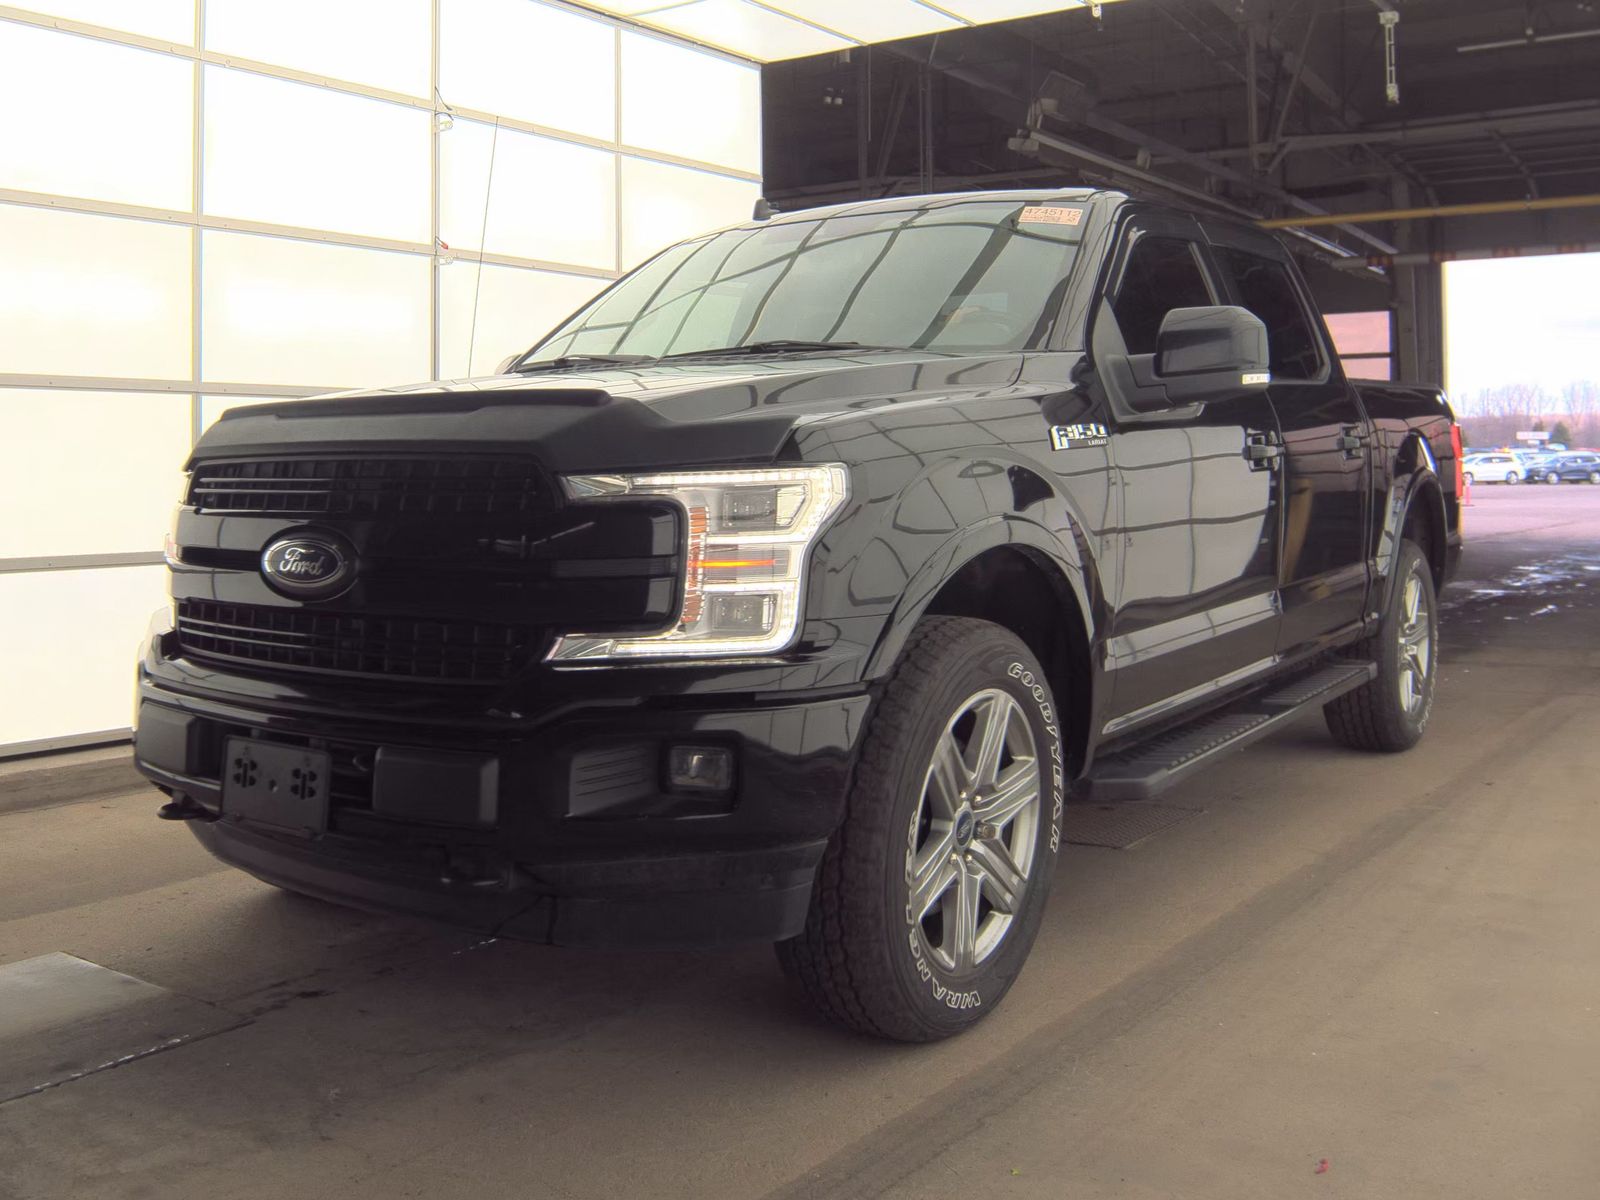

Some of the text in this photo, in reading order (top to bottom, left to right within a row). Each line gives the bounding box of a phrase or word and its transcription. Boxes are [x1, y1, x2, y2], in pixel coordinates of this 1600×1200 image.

[1024, 207, 1082, 218] 4745112
[280, 547, 325, 576] Ford
[1007, 662, 1063, 853] GOODYEAR
